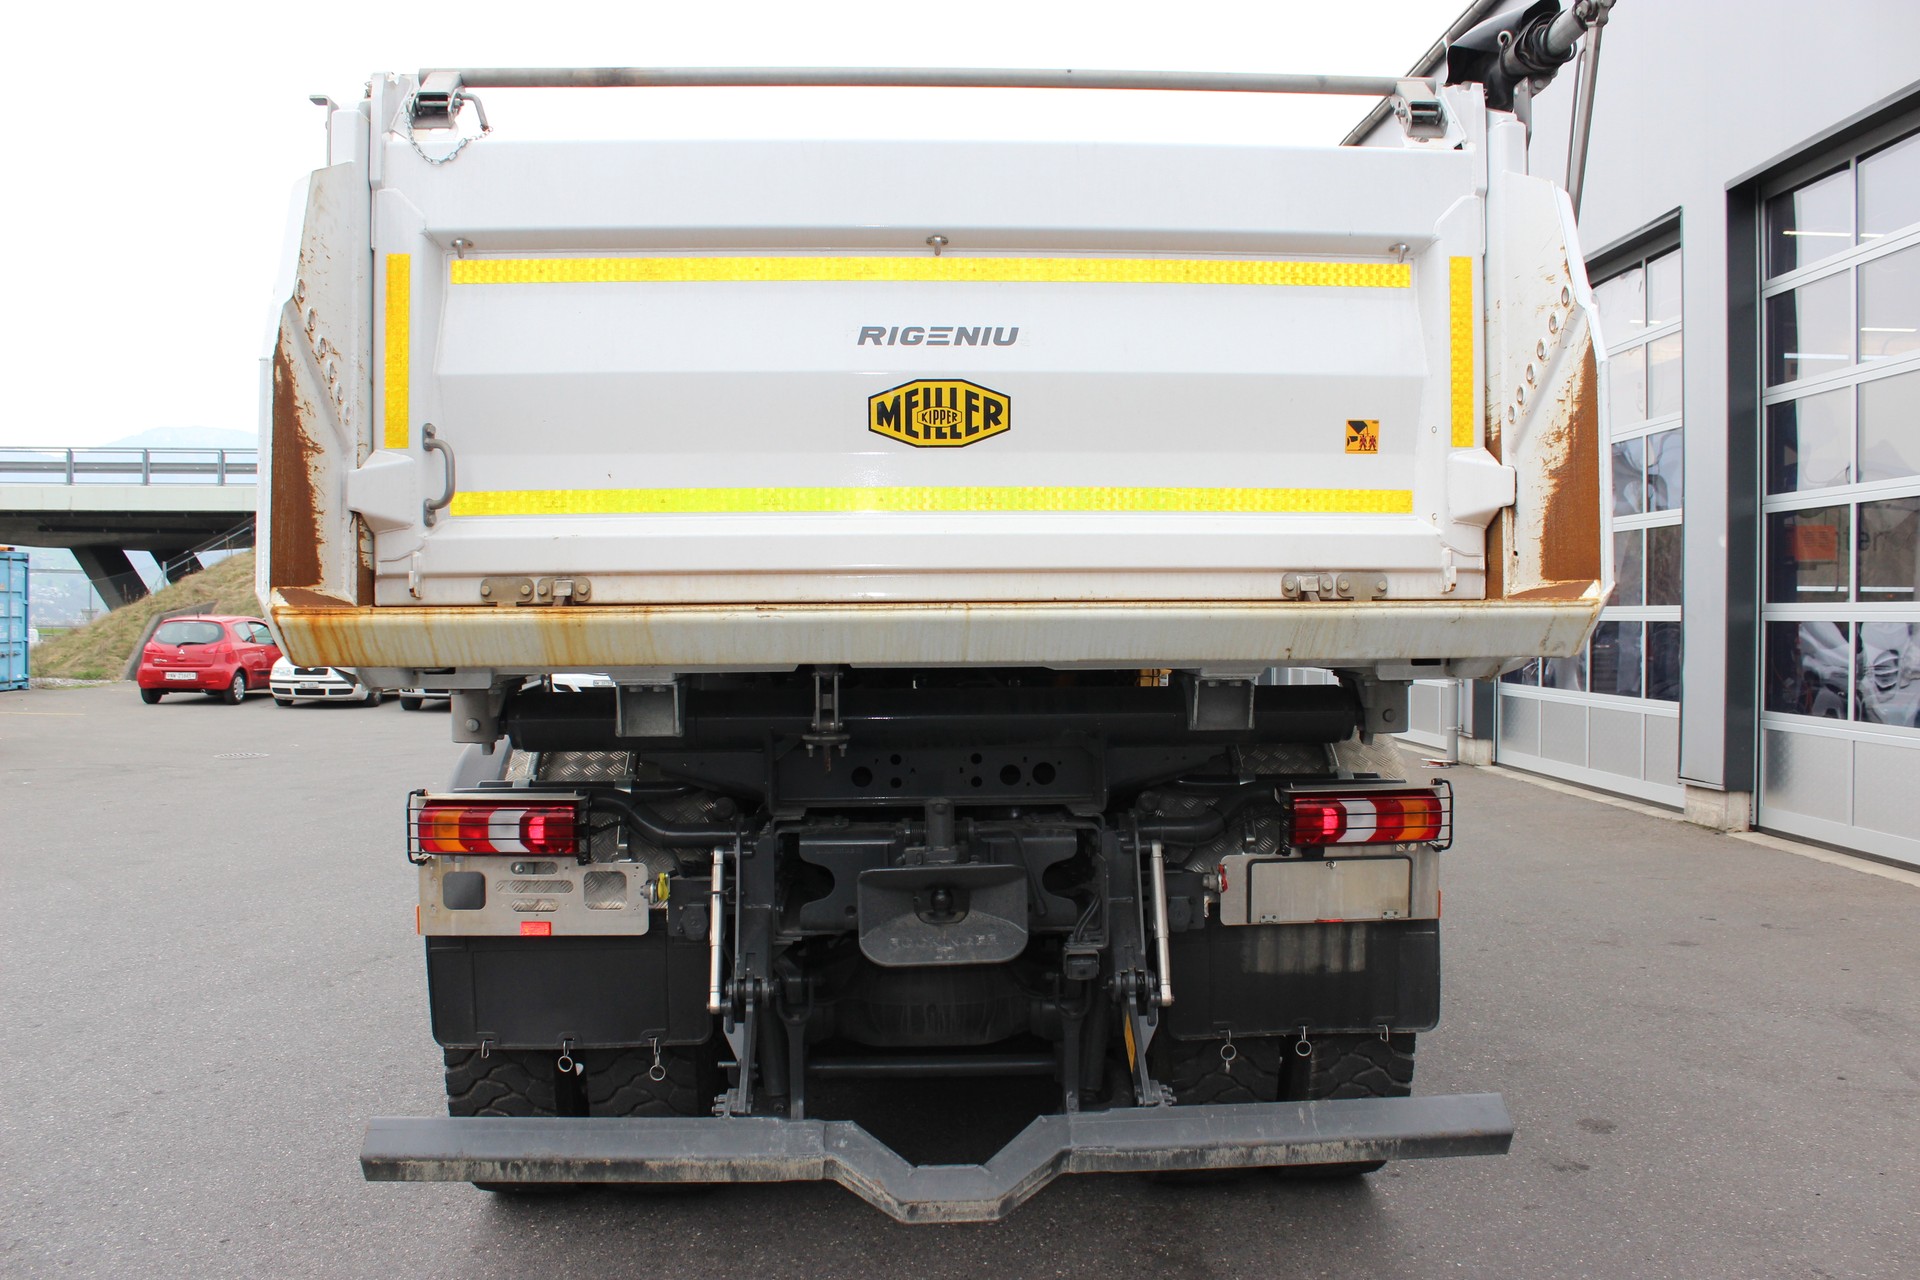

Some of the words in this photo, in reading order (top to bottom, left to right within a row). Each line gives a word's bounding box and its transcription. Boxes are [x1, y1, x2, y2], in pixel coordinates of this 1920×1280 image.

[857, 326, 1019, 346] RIGENIU
[876, 387, 1004, 440] MEILLER
[921, 409, 958, 425] KIPPER
